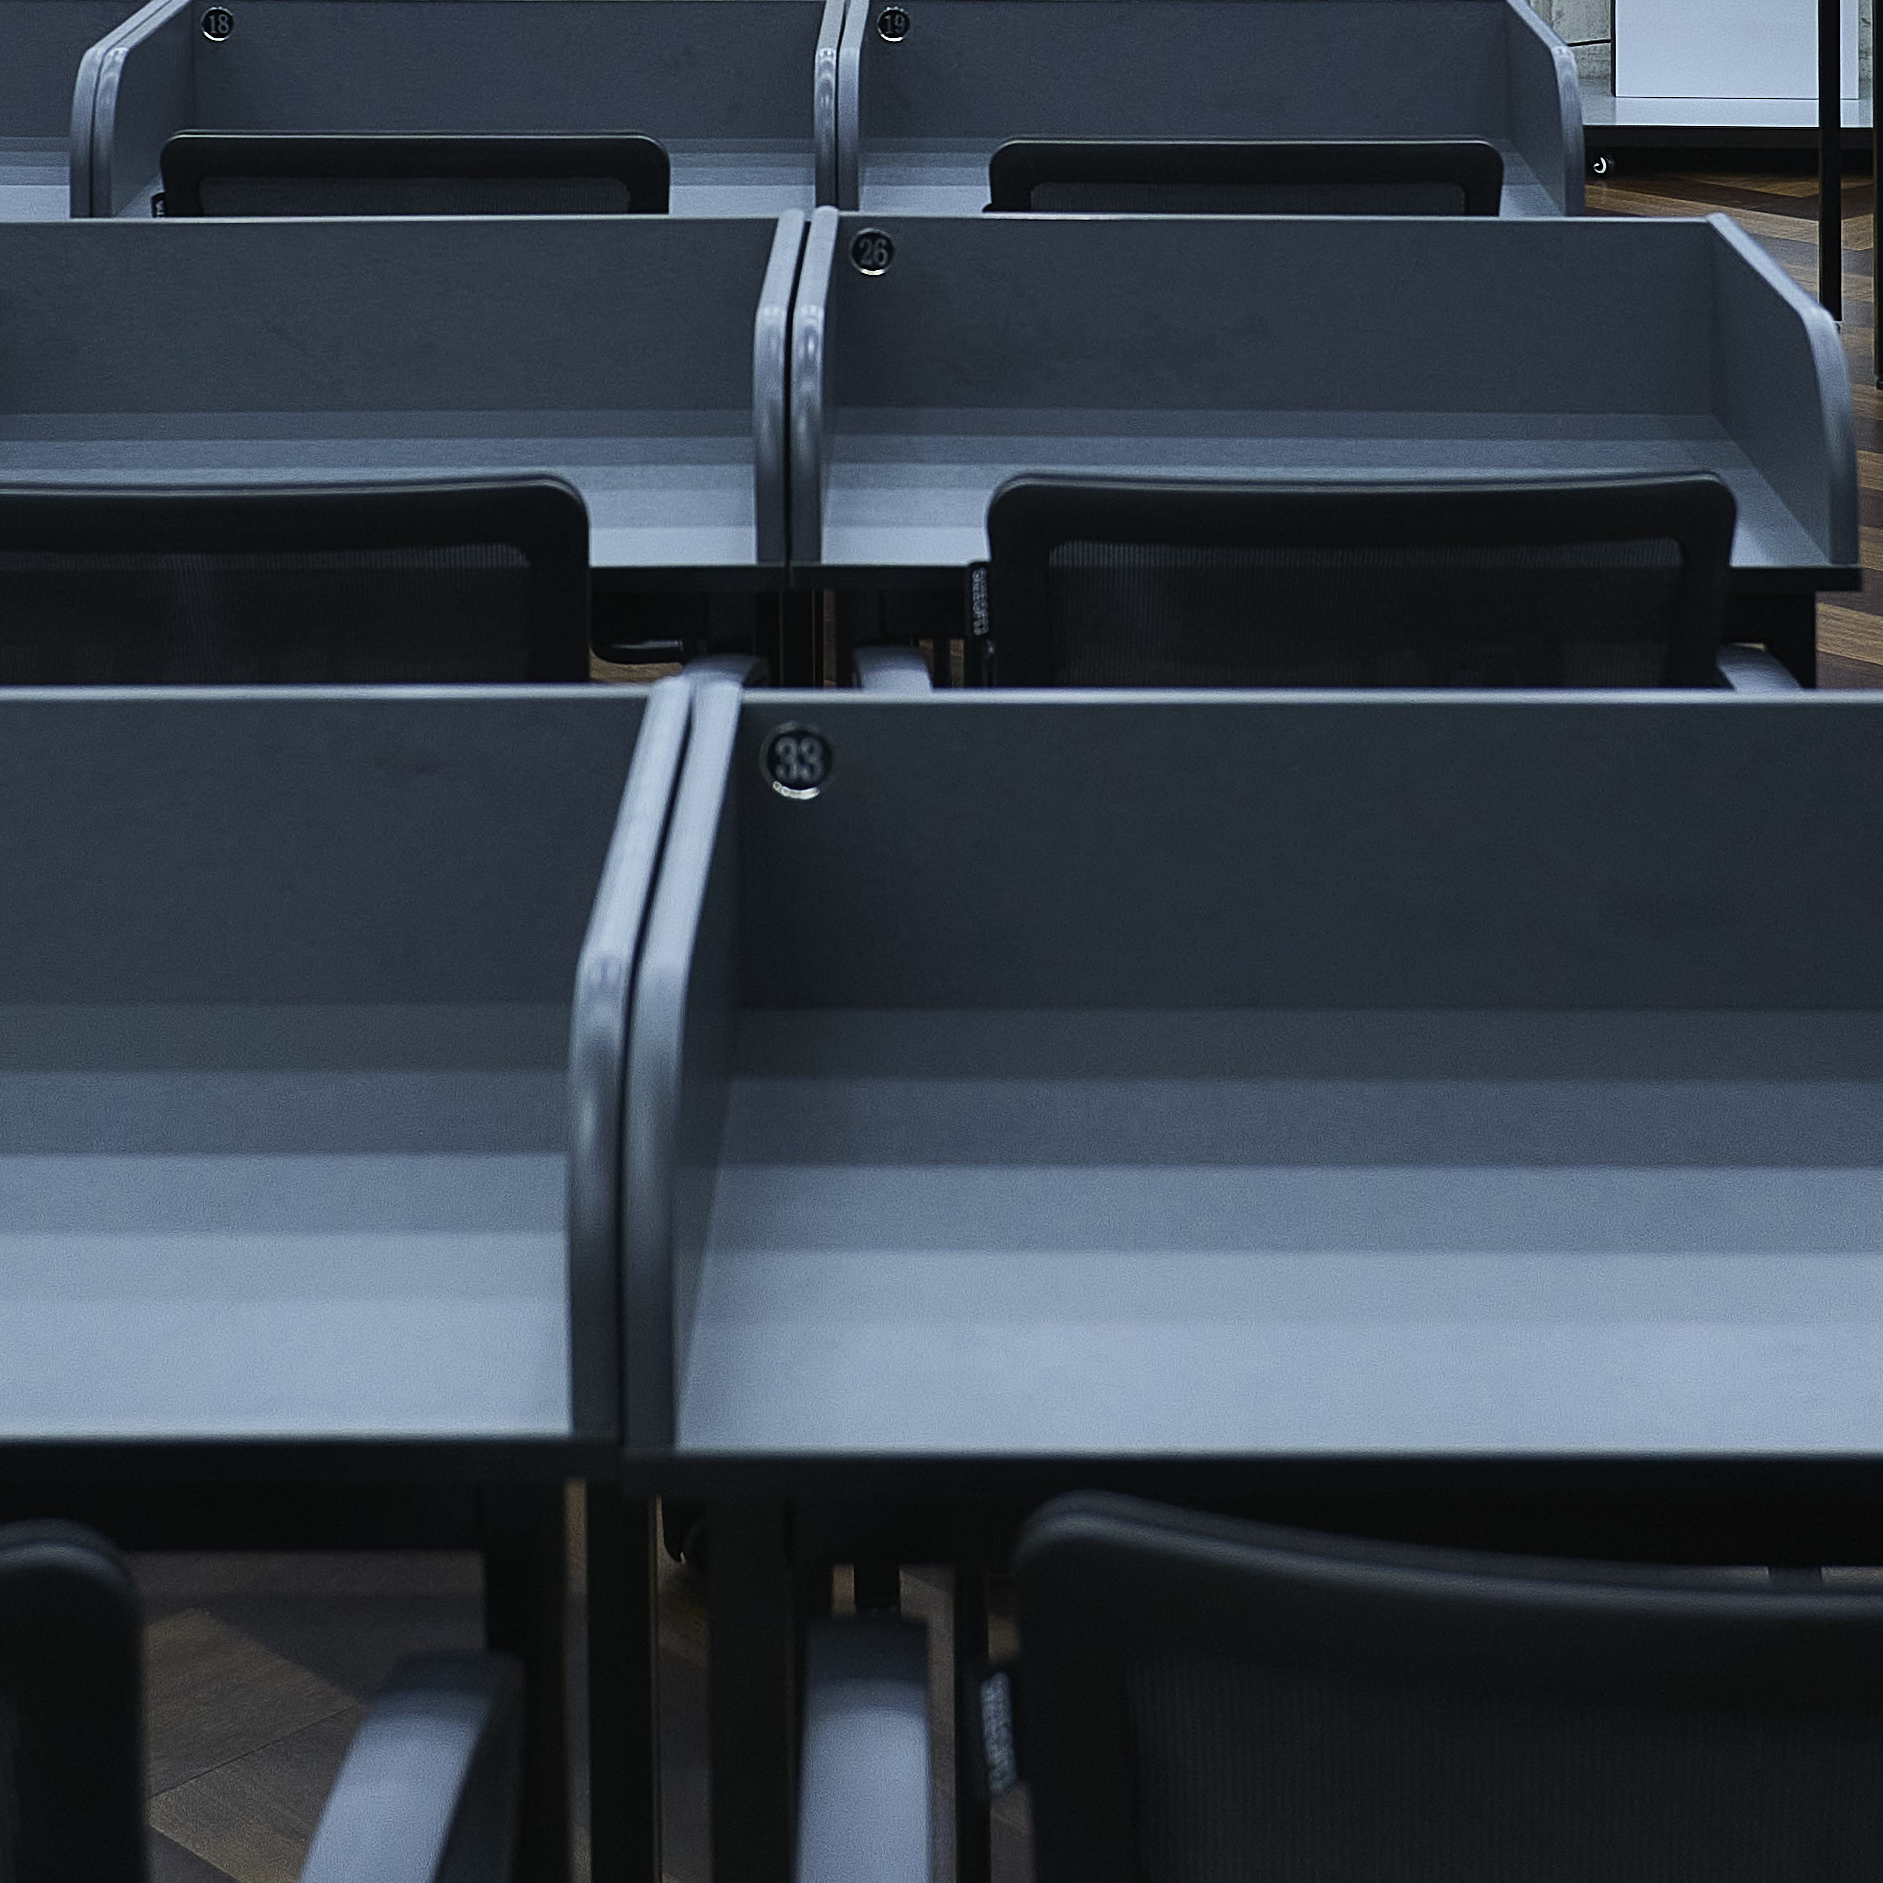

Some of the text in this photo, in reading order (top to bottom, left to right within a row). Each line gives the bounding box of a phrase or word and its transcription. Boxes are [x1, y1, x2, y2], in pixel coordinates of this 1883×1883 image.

[209, 14, 230, 33] 18
[884, 14, 905, 35] 19
[858, 239, 889, 264] 26
